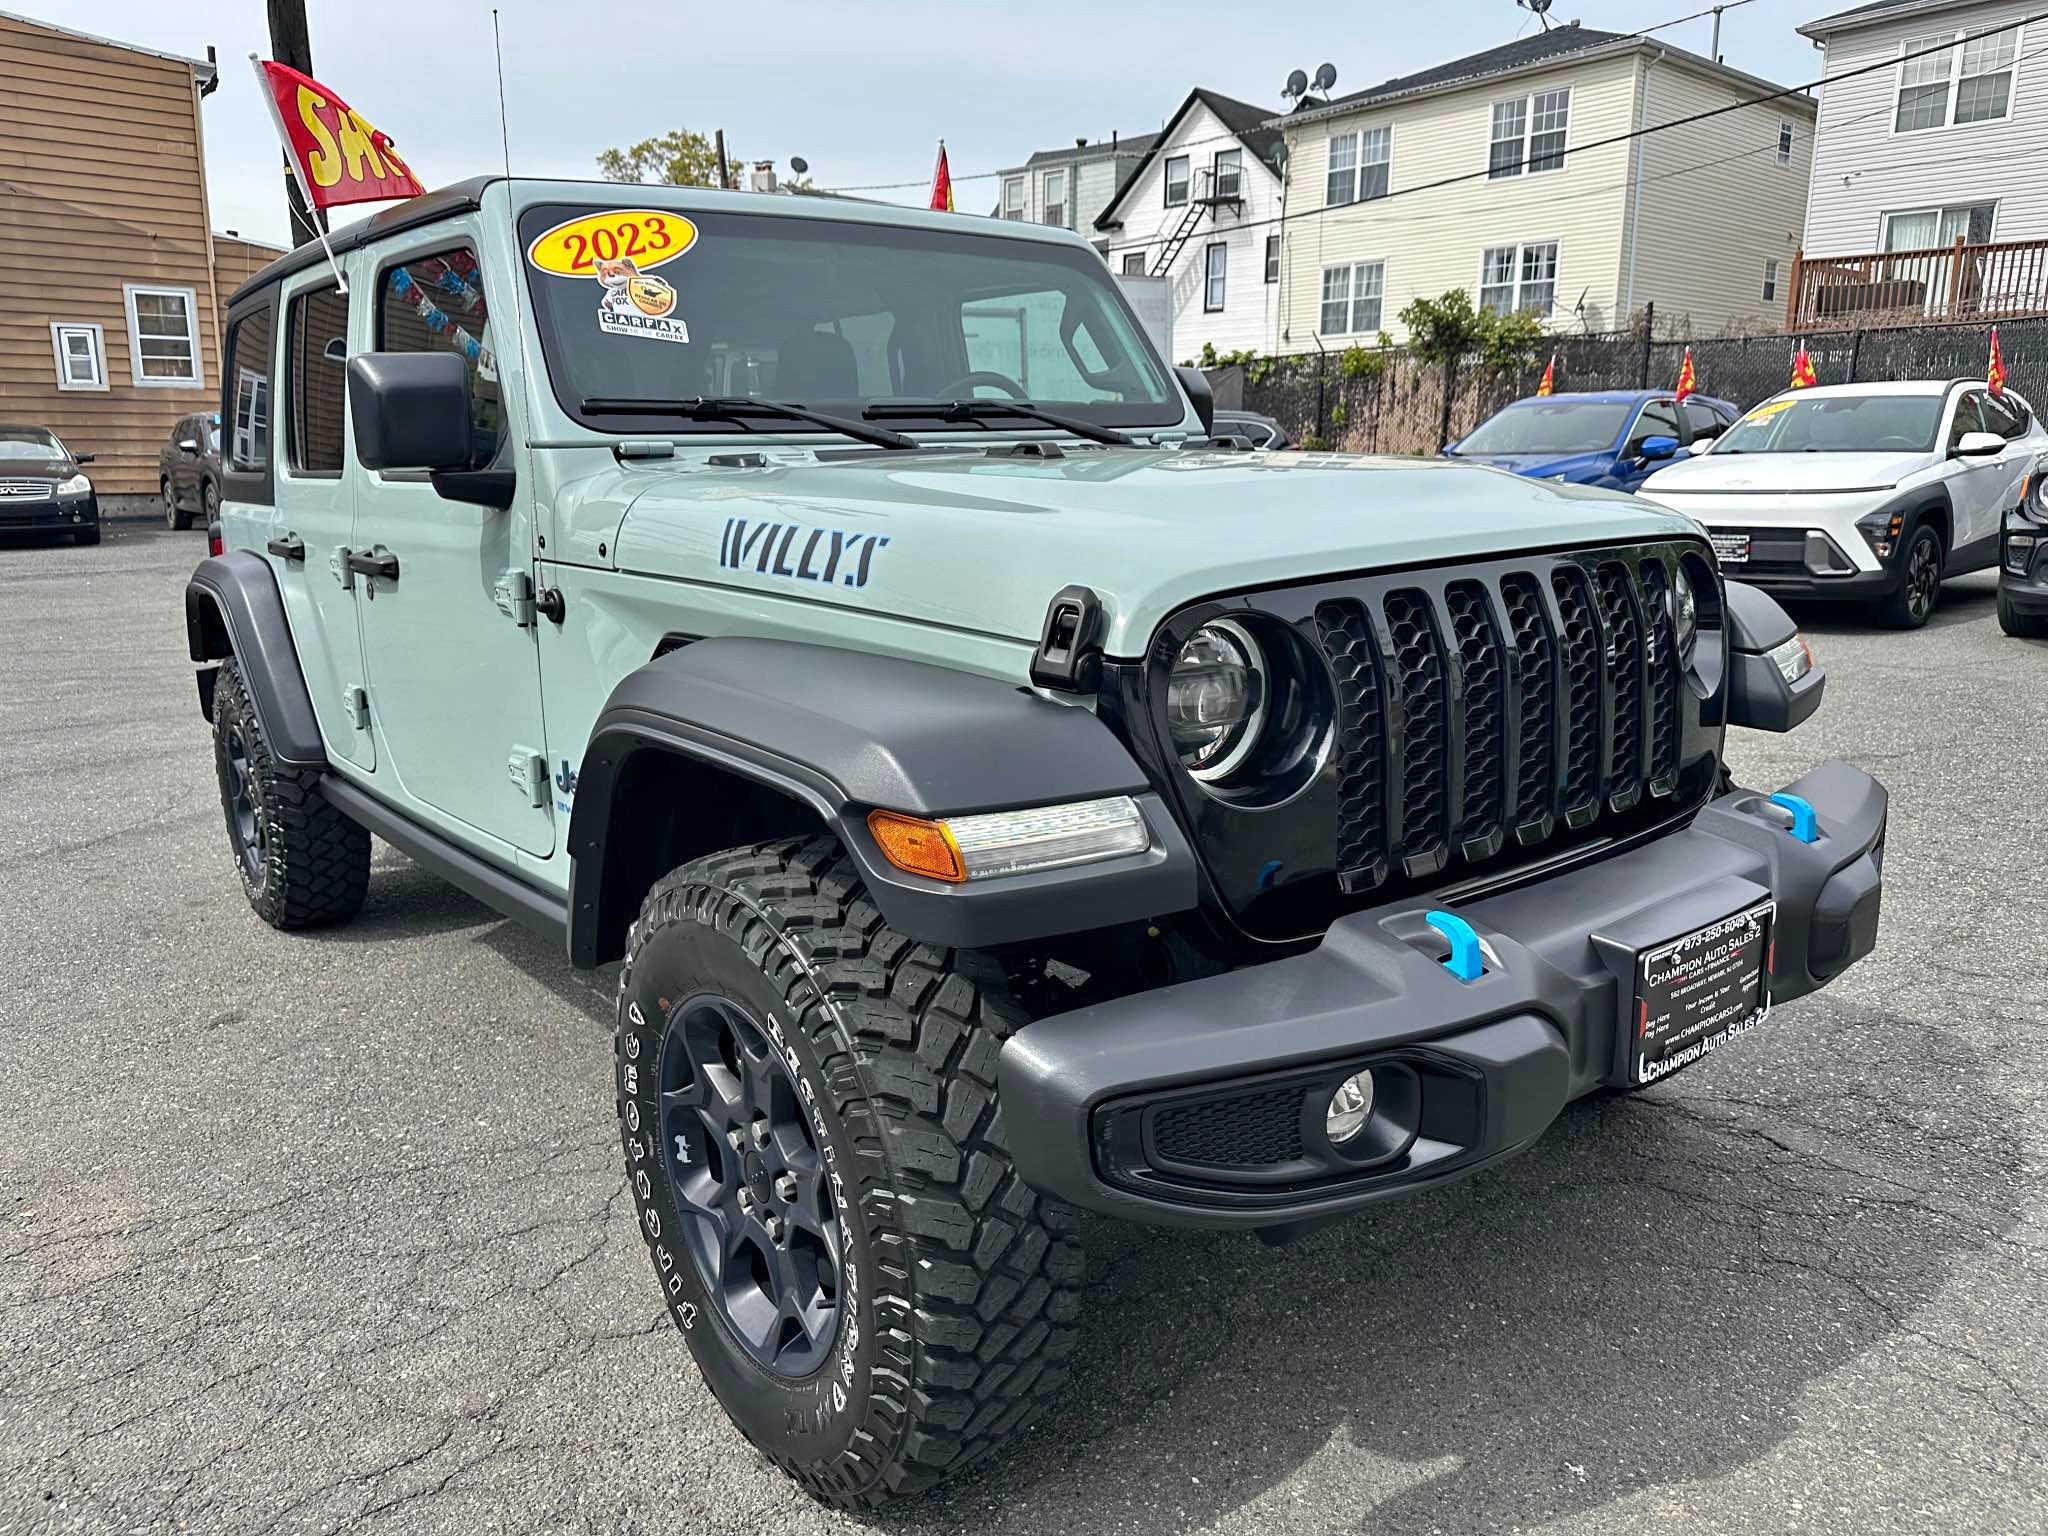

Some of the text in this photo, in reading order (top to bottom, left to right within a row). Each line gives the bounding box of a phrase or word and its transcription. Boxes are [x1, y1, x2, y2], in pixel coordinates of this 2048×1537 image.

[297, 84, 422, 187] SA
[563, 217, 671, 270] 2023
[612, 297, 629, 305] FOX
[604, 313, 682, 334] CARFAX
[606, 325, 628, 333] SHOW
[655, 332, 684, 341] CARFAX
[720, 517, 891, 588] WILLYS
[556, 759, 578, 795] Je
[1684, 916, 1745, 951] 973-250-6049
[1649, 925, 1760, 987] CHAMPION AUTO SALES 2
[1688, 967, 1704, 979] CARS
[1645, 1012, 1671, 1030] Buy Here
[1700, 1001, 1717, 1014] Credit
[1644, 1023, 1670, 1040] Pay Here
[1647, 1008, 1763, 1081] CHAMPION AUTO SALES 2
